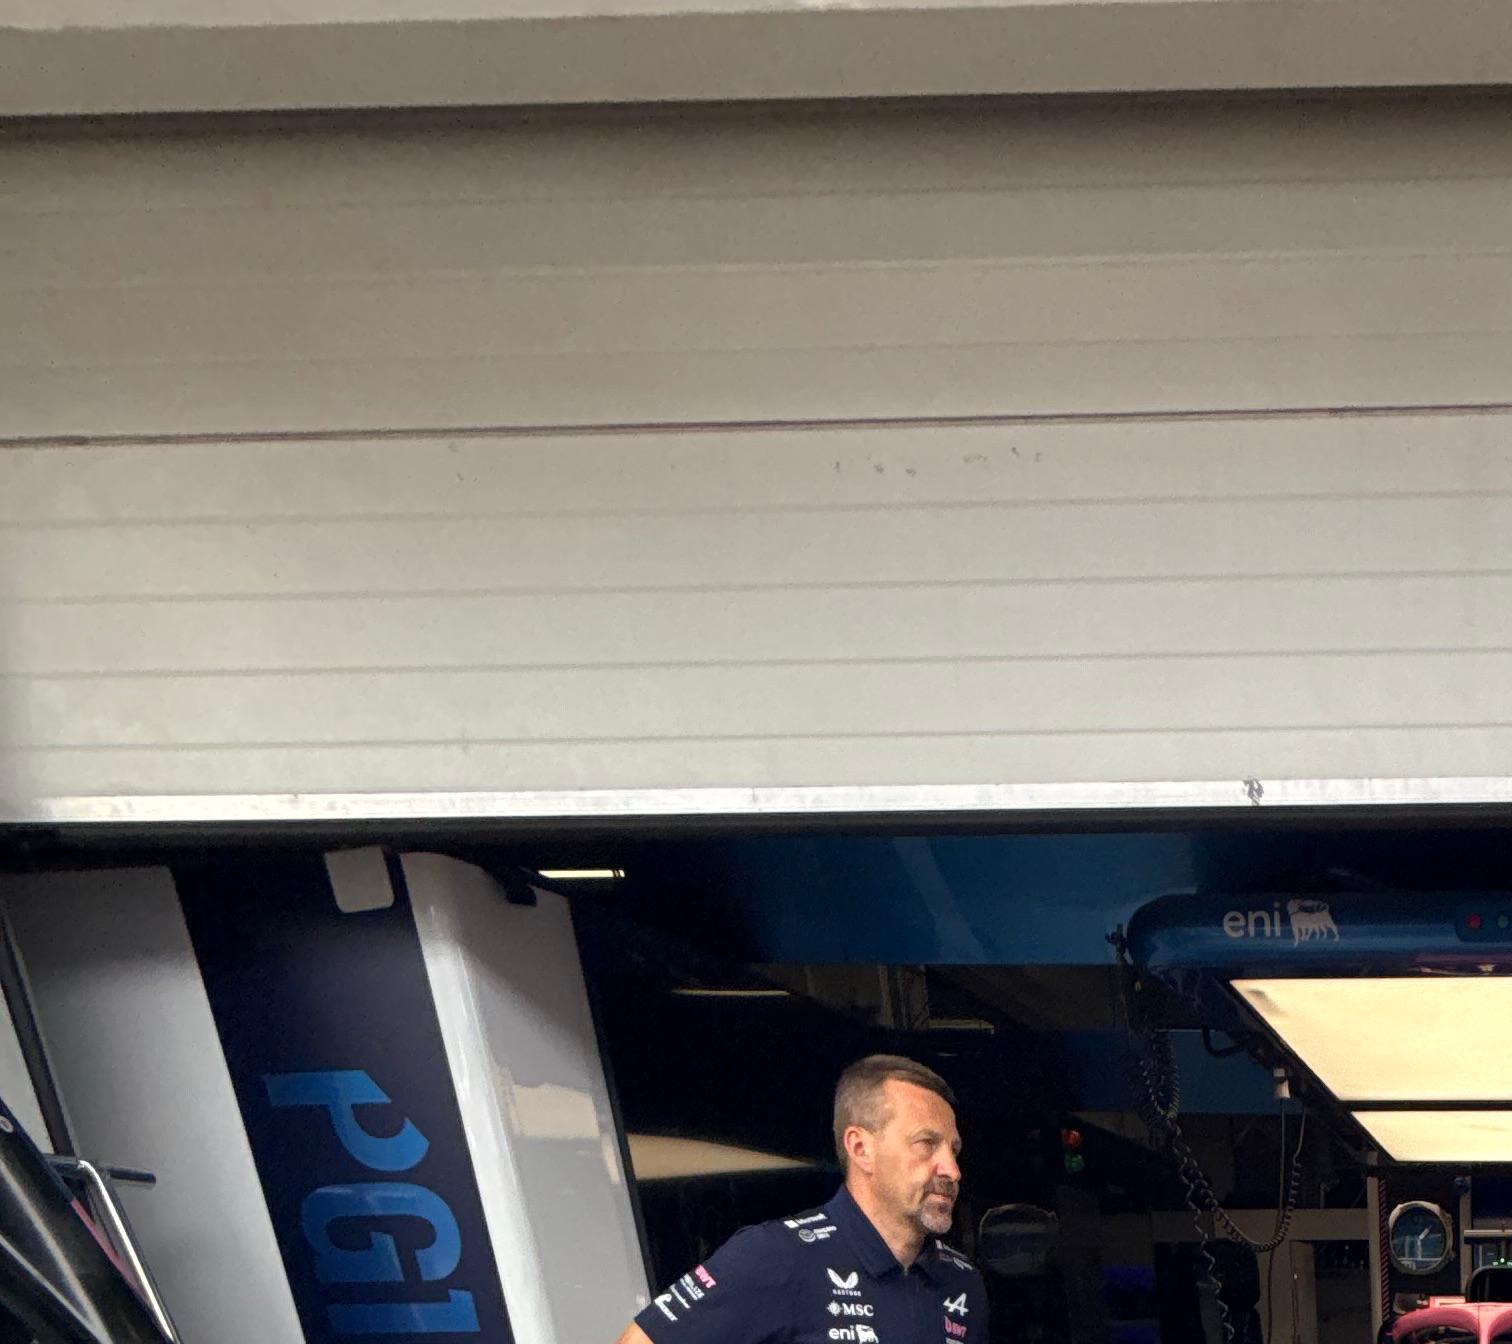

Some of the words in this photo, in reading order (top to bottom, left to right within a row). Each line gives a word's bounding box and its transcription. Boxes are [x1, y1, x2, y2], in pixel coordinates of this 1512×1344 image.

[1223, 901, 1281, 938] eni
[842, 1302, 875, 1317] MSC
[828, 1324, 856, 1341] eni
